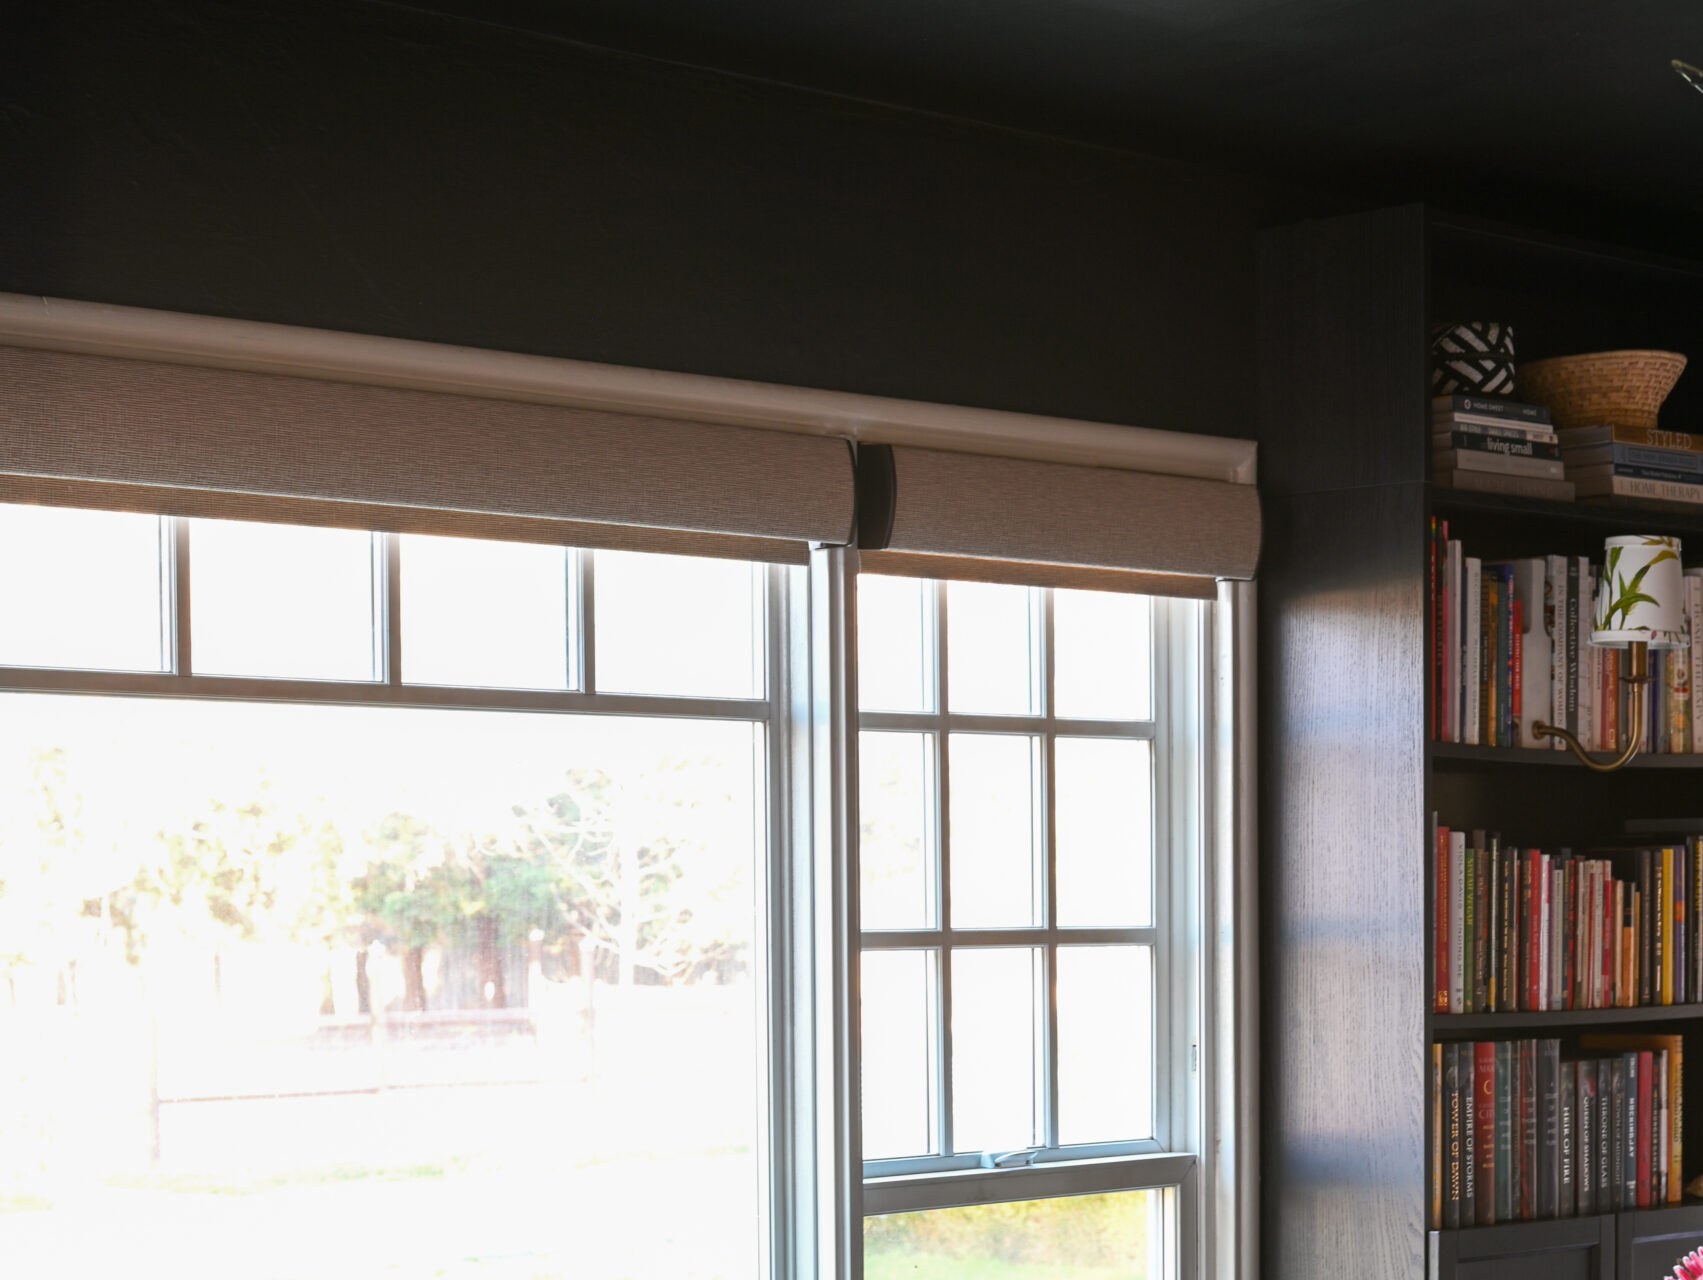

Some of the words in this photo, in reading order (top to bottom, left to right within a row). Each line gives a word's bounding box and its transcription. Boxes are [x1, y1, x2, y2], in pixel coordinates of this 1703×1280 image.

[1487, 436, 1509, 455] living
[1510, 441, 1533, 456] small
[1647, 428, 1692, 449] STYLED
[1630, 482, 1656, 495] HOME
[1662, 484, 1701, 500] THERAPY
[1568, 598, 1577, 659] Collective
[1557, 672, 1564, 684] OF
[1568, 662, 1577, 712] Wisdom
[1694, 655, 1703, 721] THERAPY
[1466, 1138, 1473, 1151] OF
[1583, 1130, 1590, 1142] OF
[1452, 1141, 1459, 1157] OF
[1563, 1138, 1570, 1155] OF
[1601, 1141, 1608, 1155] OF
